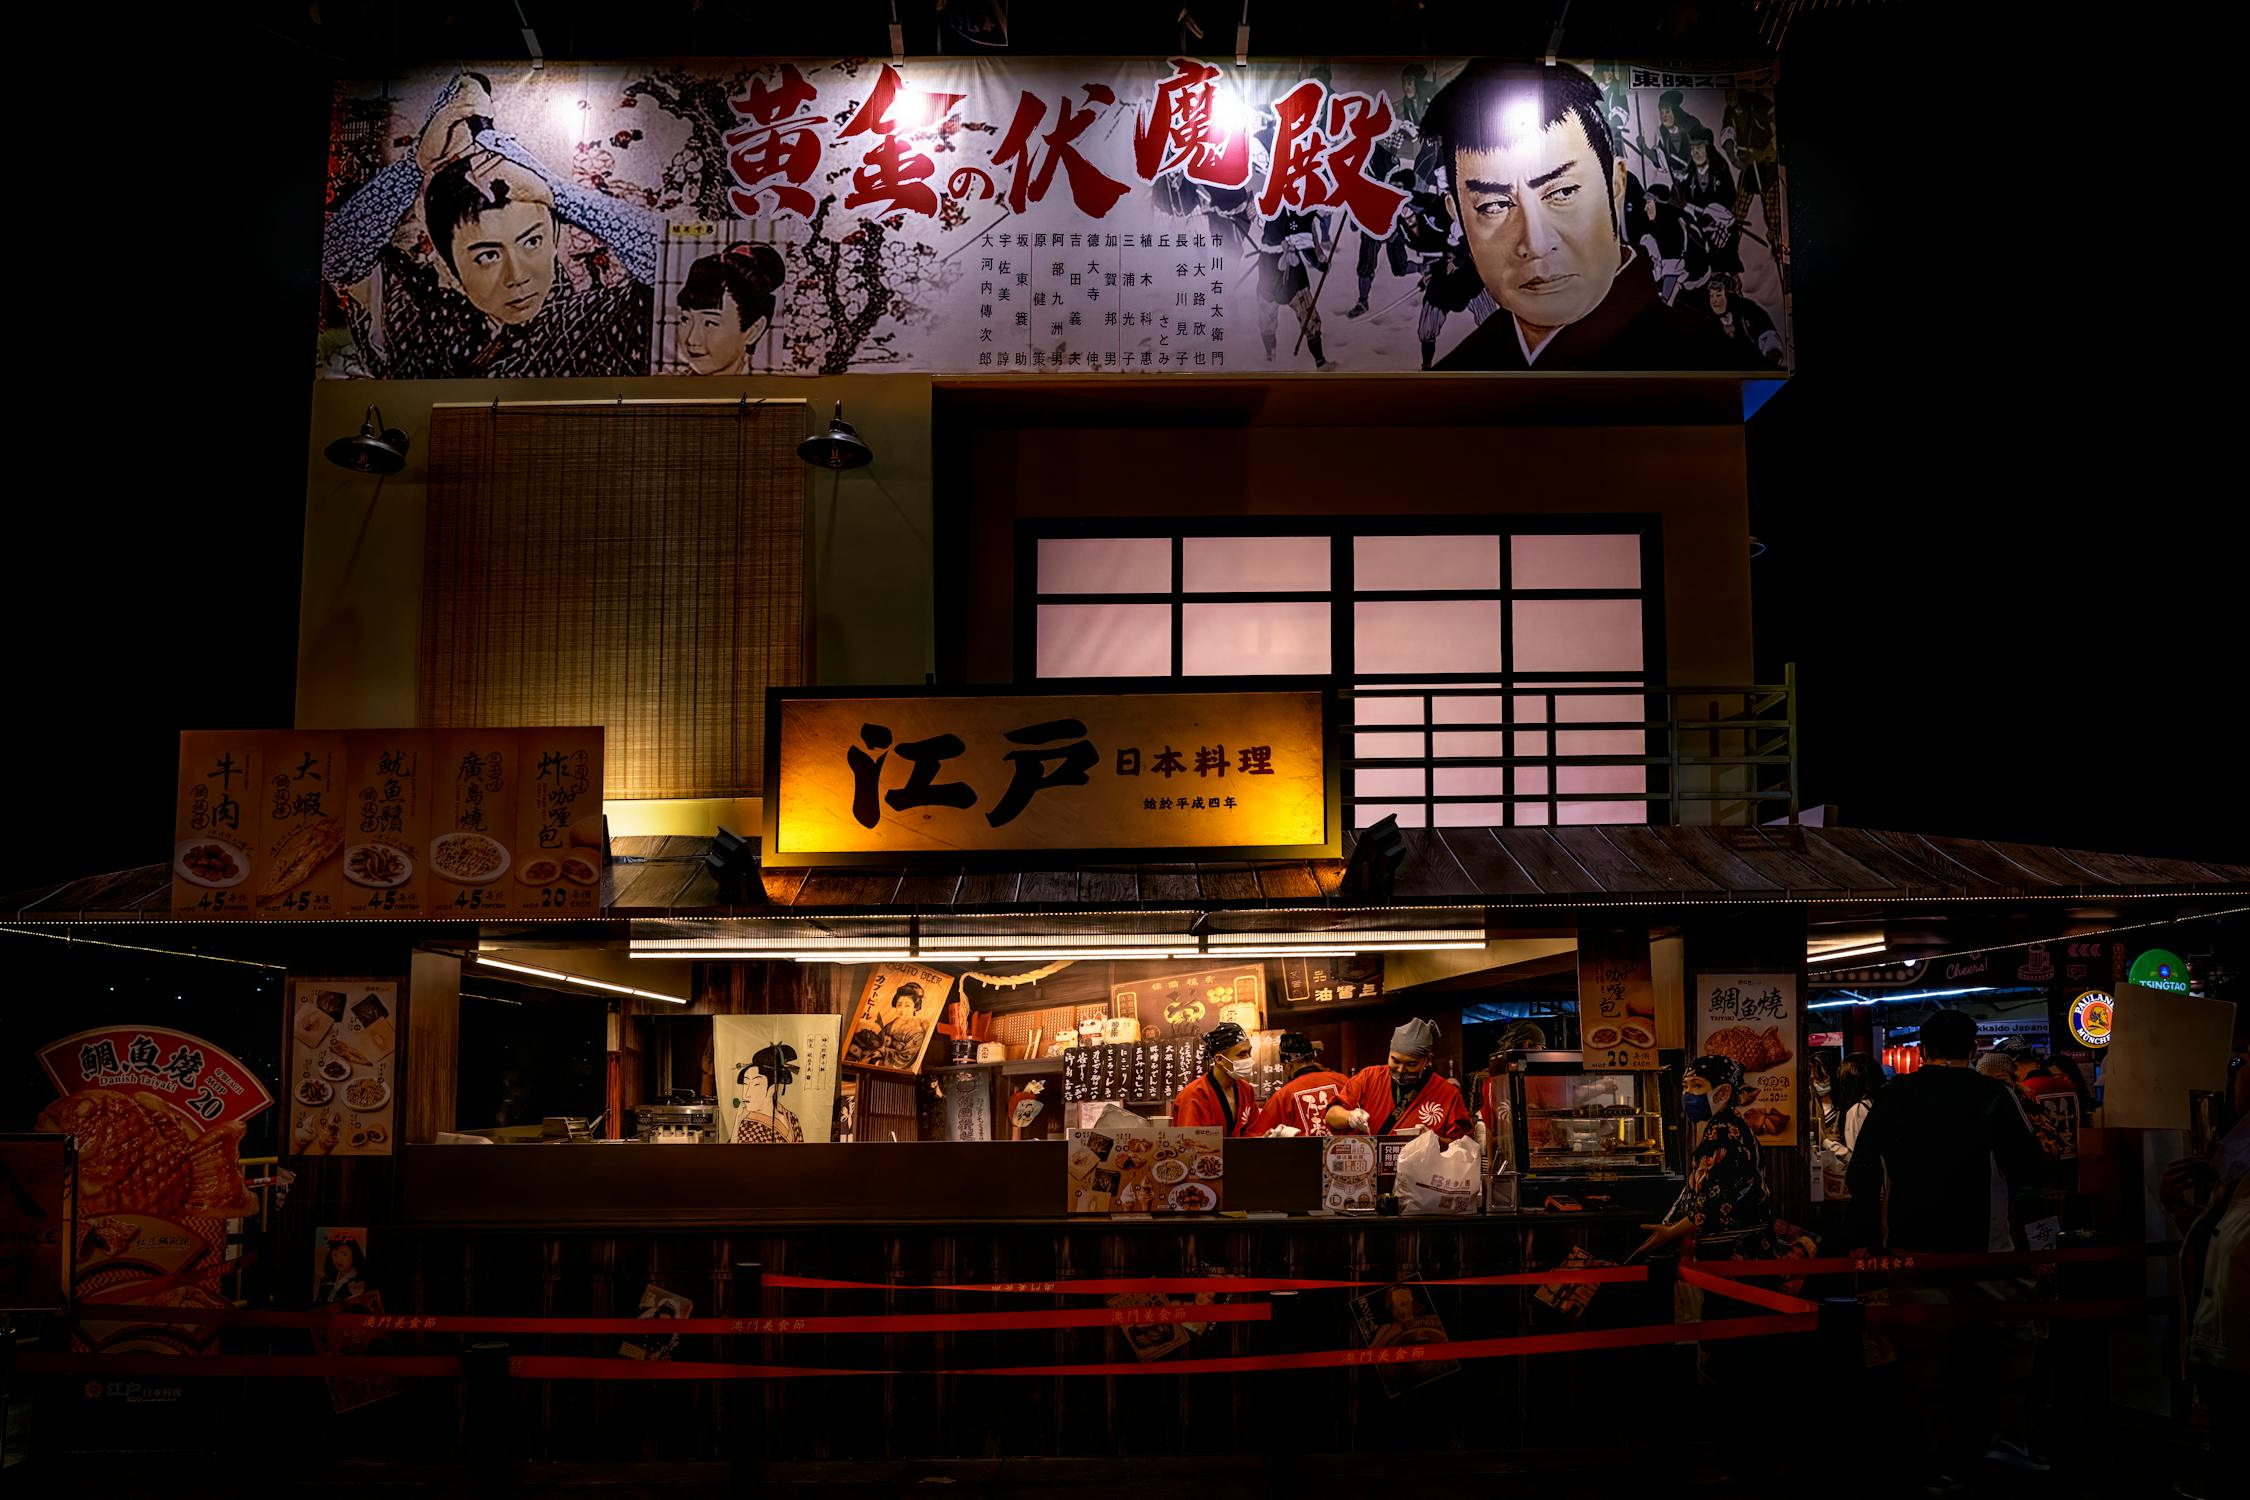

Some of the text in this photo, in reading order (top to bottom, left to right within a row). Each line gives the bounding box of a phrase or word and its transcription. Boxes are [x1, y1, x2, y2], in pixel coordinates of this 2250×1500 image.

[1104, 233, 1117, 366] 加賀邦男
[1122, 233, 1135, 366] 三浦光子
[1158, 233, 1171, 366] 丘さとみ
[1193, 233, 1206, 366] 北大路欣也
[1116, 744, 1275, 778] 日本料理
[207, 752, 243, 831] 牛肉
[292, 752, 330, 819] 大蝦
[456, 750, 488, 832] 廣島燒
[536, 751, 577, 849] 炸咖喱包
[1143, 795, 1238, 811] 始於平成四年
[198, 891, 227, 911] 45
[283, 891, 312, 911] 45
[368, 889, 397, 910] 45
[453, 889, 483, 909] 45
[542, 888, 566, 907] 20
[920, 971, 943, 985] BEER
[1946, 956, 1990, 980] Cheers!
[2139, 980, 2187, 991] TSINGTAO
[1708, 987, 1788, 1022] 鯛魚燒
[1977, 1024, 2010, 1033] kkaido
[2077, 1028, 2112, 1045] MÜNCHE
[79, 1035, 205, 1088] 鯛魚燒
[1607, 1050, 1629, 1067] 20
[99, 1074, 138, 1087] Danish
[204, 1076, 228, 1096] MOP
[186, 1086, 225, 1120] 20
[1854, 1256, 1914, 1271] 澳門美食節
[362, 1315, 437, 1329] 澳門美食節
[730, 1319, 807, 1331] 澳門美食節
[1111, 1308, 1186, 1323] 澳門美食節
